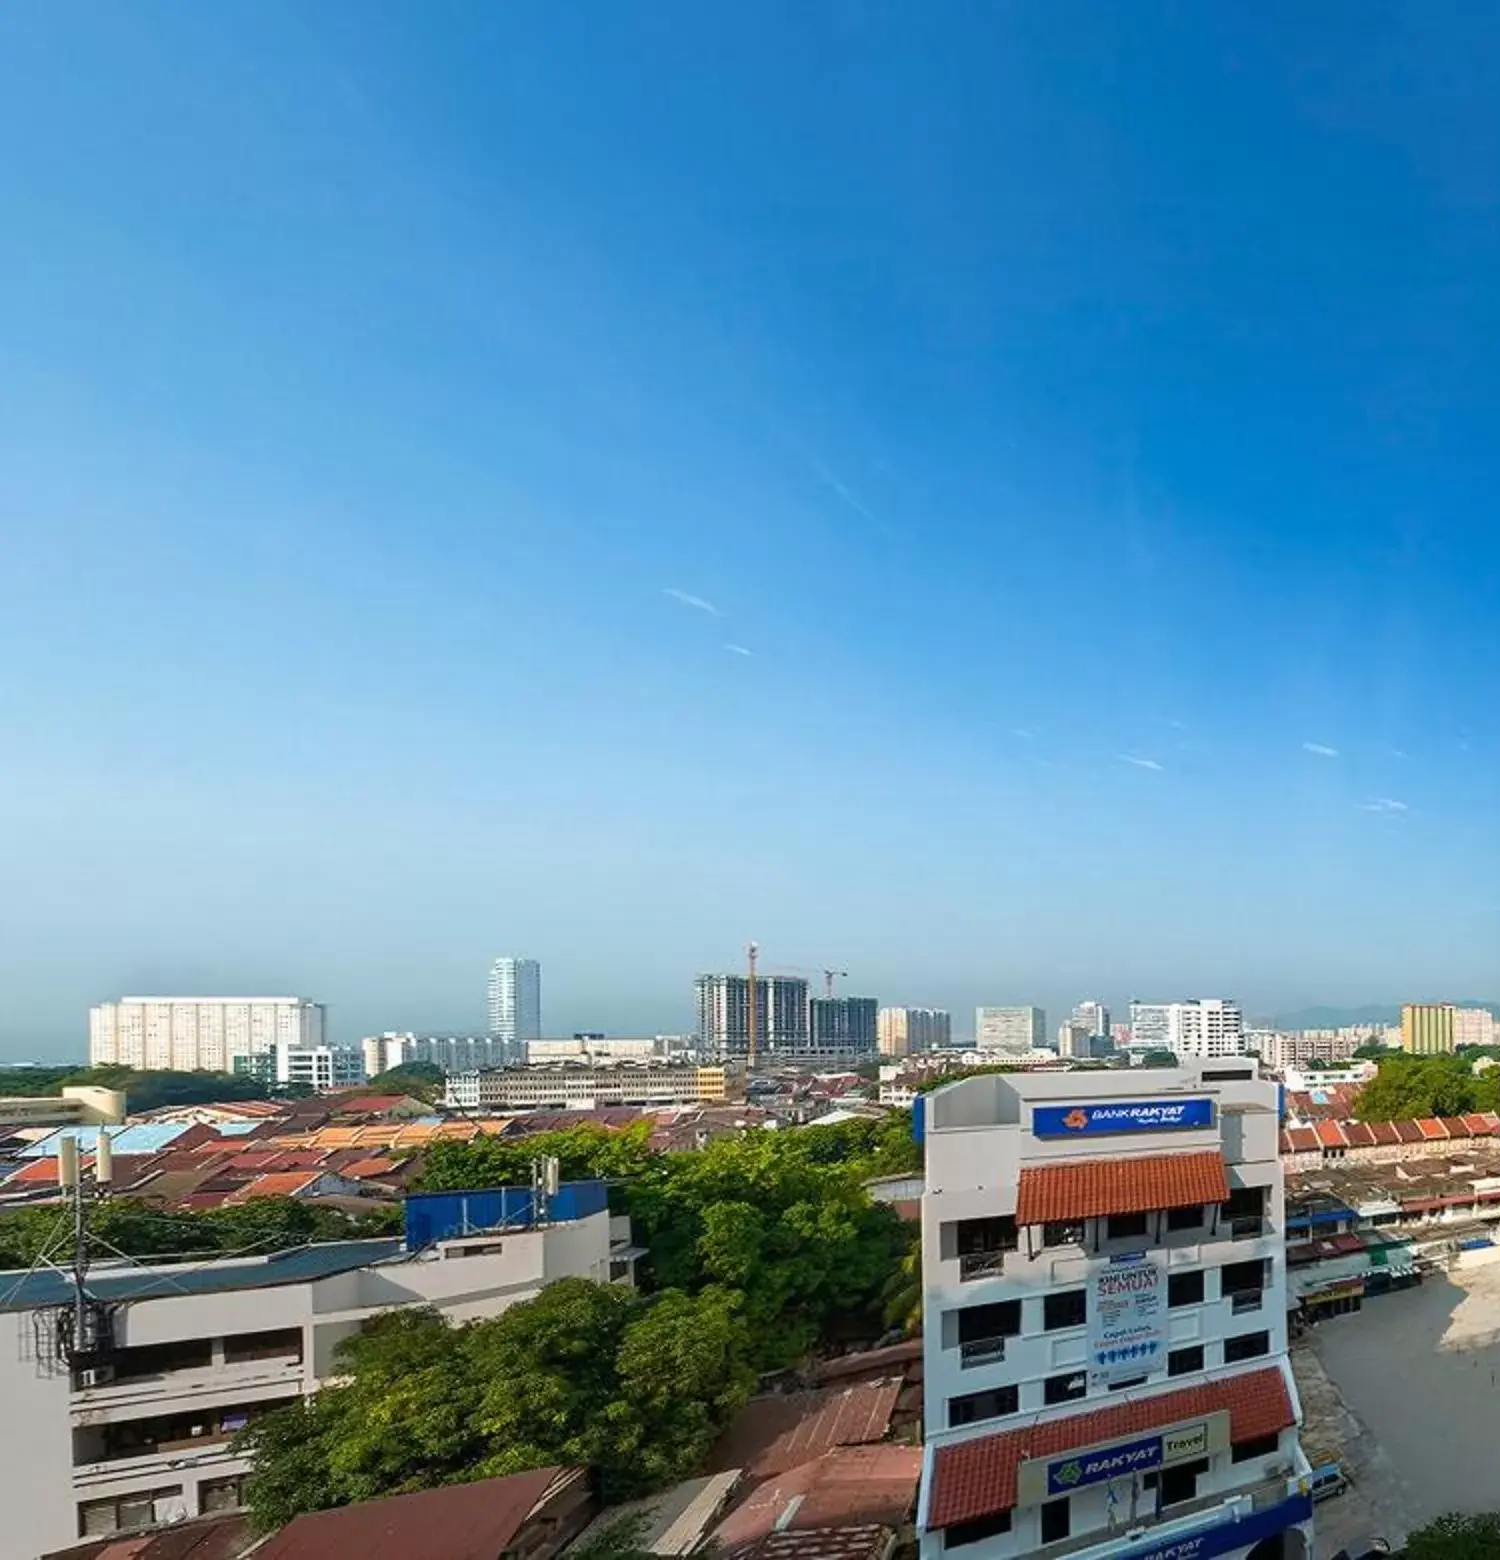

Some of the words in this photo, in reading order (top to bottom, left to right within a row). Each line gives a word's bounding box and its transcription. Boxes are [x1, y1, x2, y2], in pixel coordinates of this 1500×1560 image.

[1092, 1109, 1130, 1121] BANK
[1130, 1105, 1185, 1118] RAKYAT
[1085, 1446, 1159, 1475] RAKYAT
[1166, 1432, 1203, 1451] Travel
